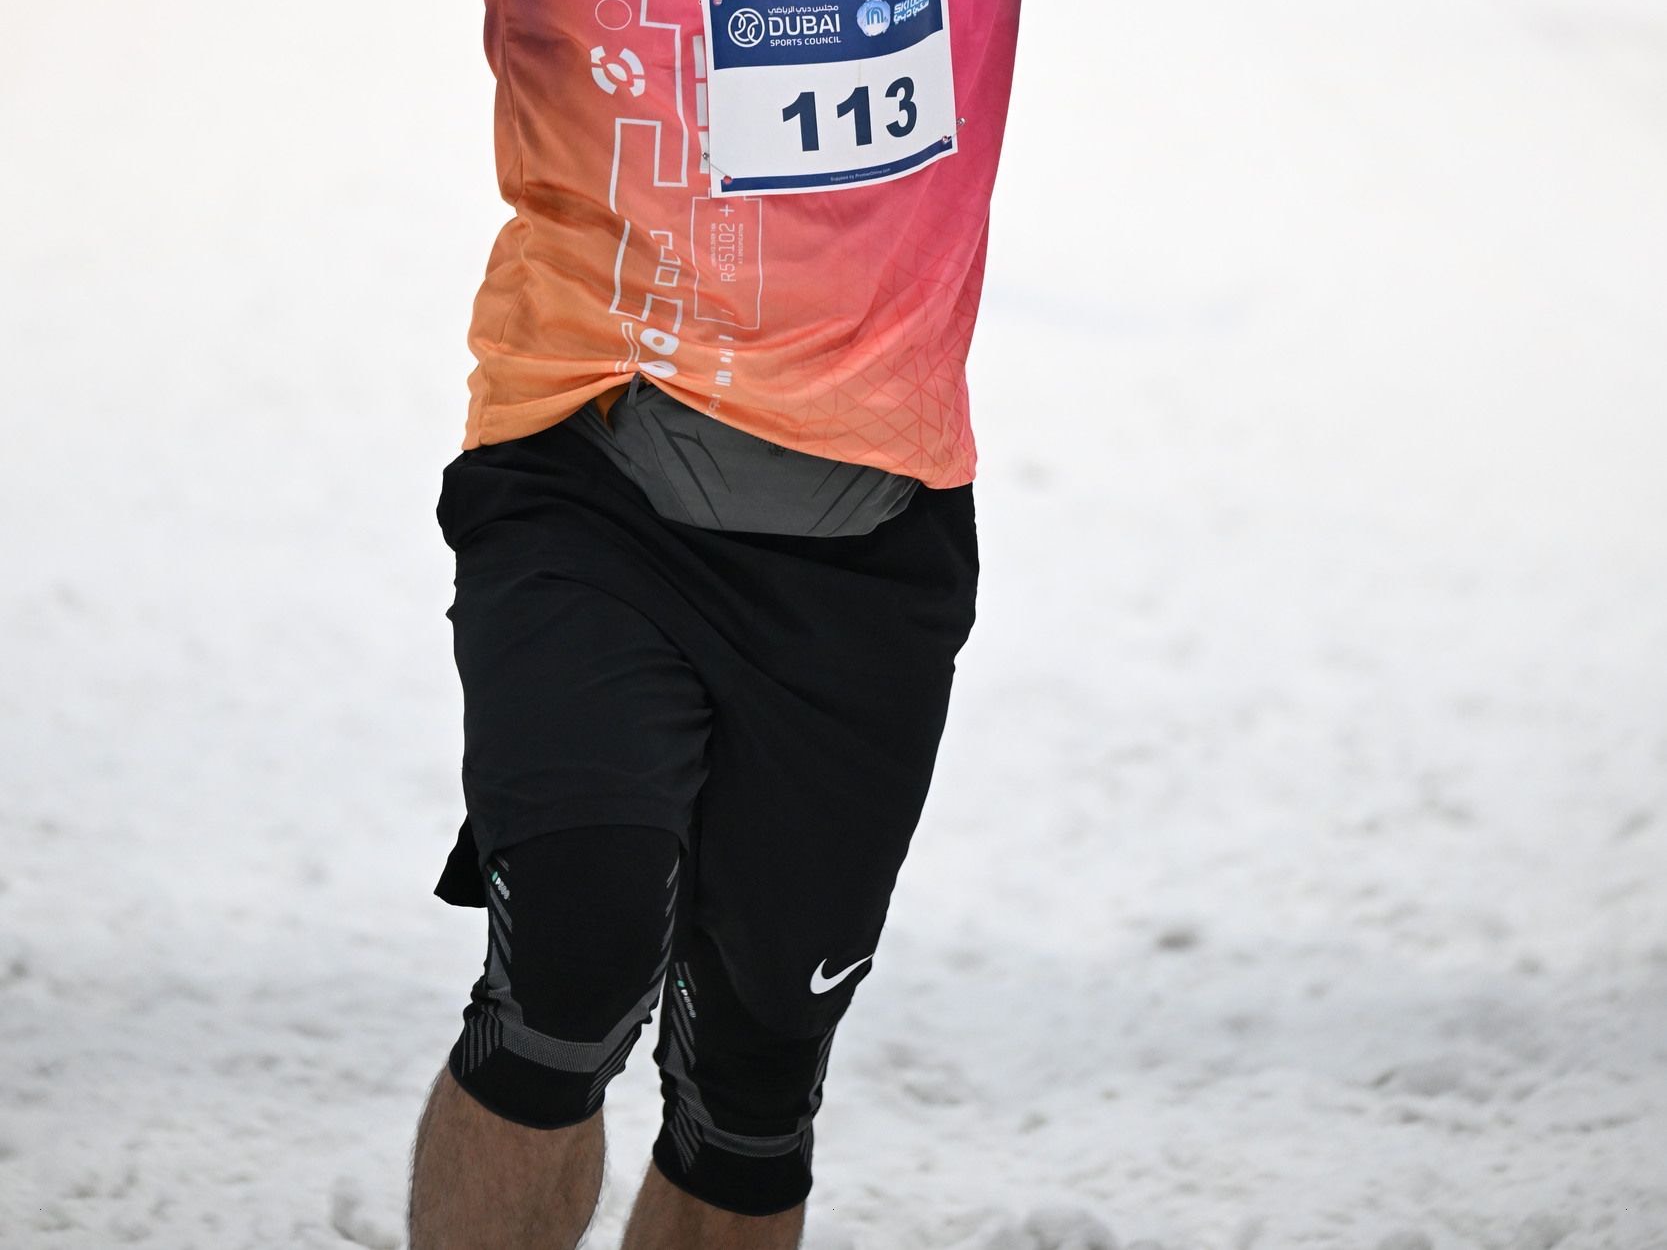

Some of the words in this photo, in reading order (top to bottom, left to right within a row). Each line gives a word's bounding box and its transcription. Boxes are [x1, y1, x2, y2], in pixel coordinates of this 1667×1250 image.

[767, 6, 795, 15] الرياضي
[795, 6, 812, 14] دبي
[812, 4, 839, 13] مجلس
[893, 0, 910, 14] SKI
[767, 13, 841, 36] DUBAI
[769, 38, 803, 47] SPORTS
[804, 36, 842, 46] COUNCIL
[782, 76, 918, 152] 113
[718, 222, 737, 283] R55102
